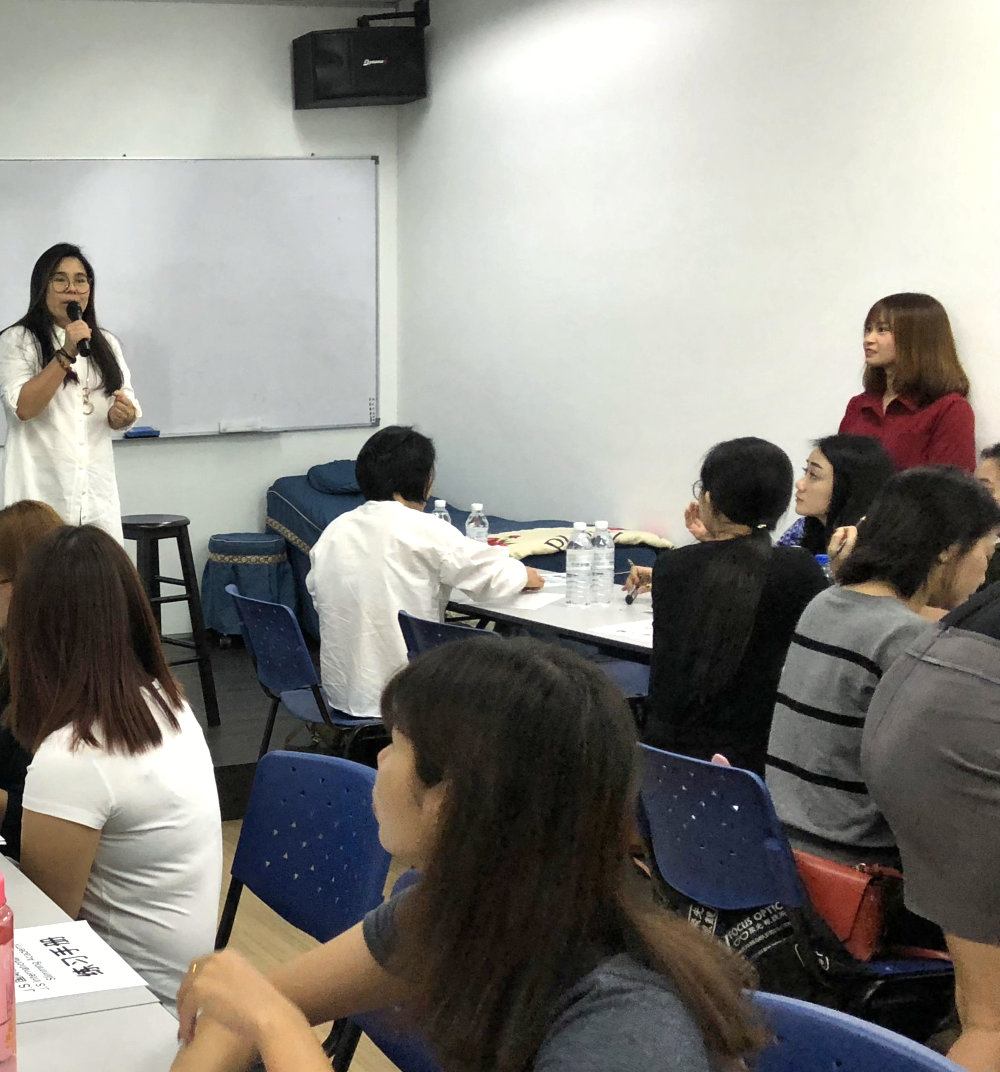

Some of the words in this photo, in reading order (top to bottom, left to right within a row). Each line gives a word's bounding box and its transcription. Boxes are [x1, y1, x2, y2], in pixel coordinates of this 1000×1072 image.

[727, 915, 754, 940] FOCUS
[40, 936, 105, 977] 练习手册
